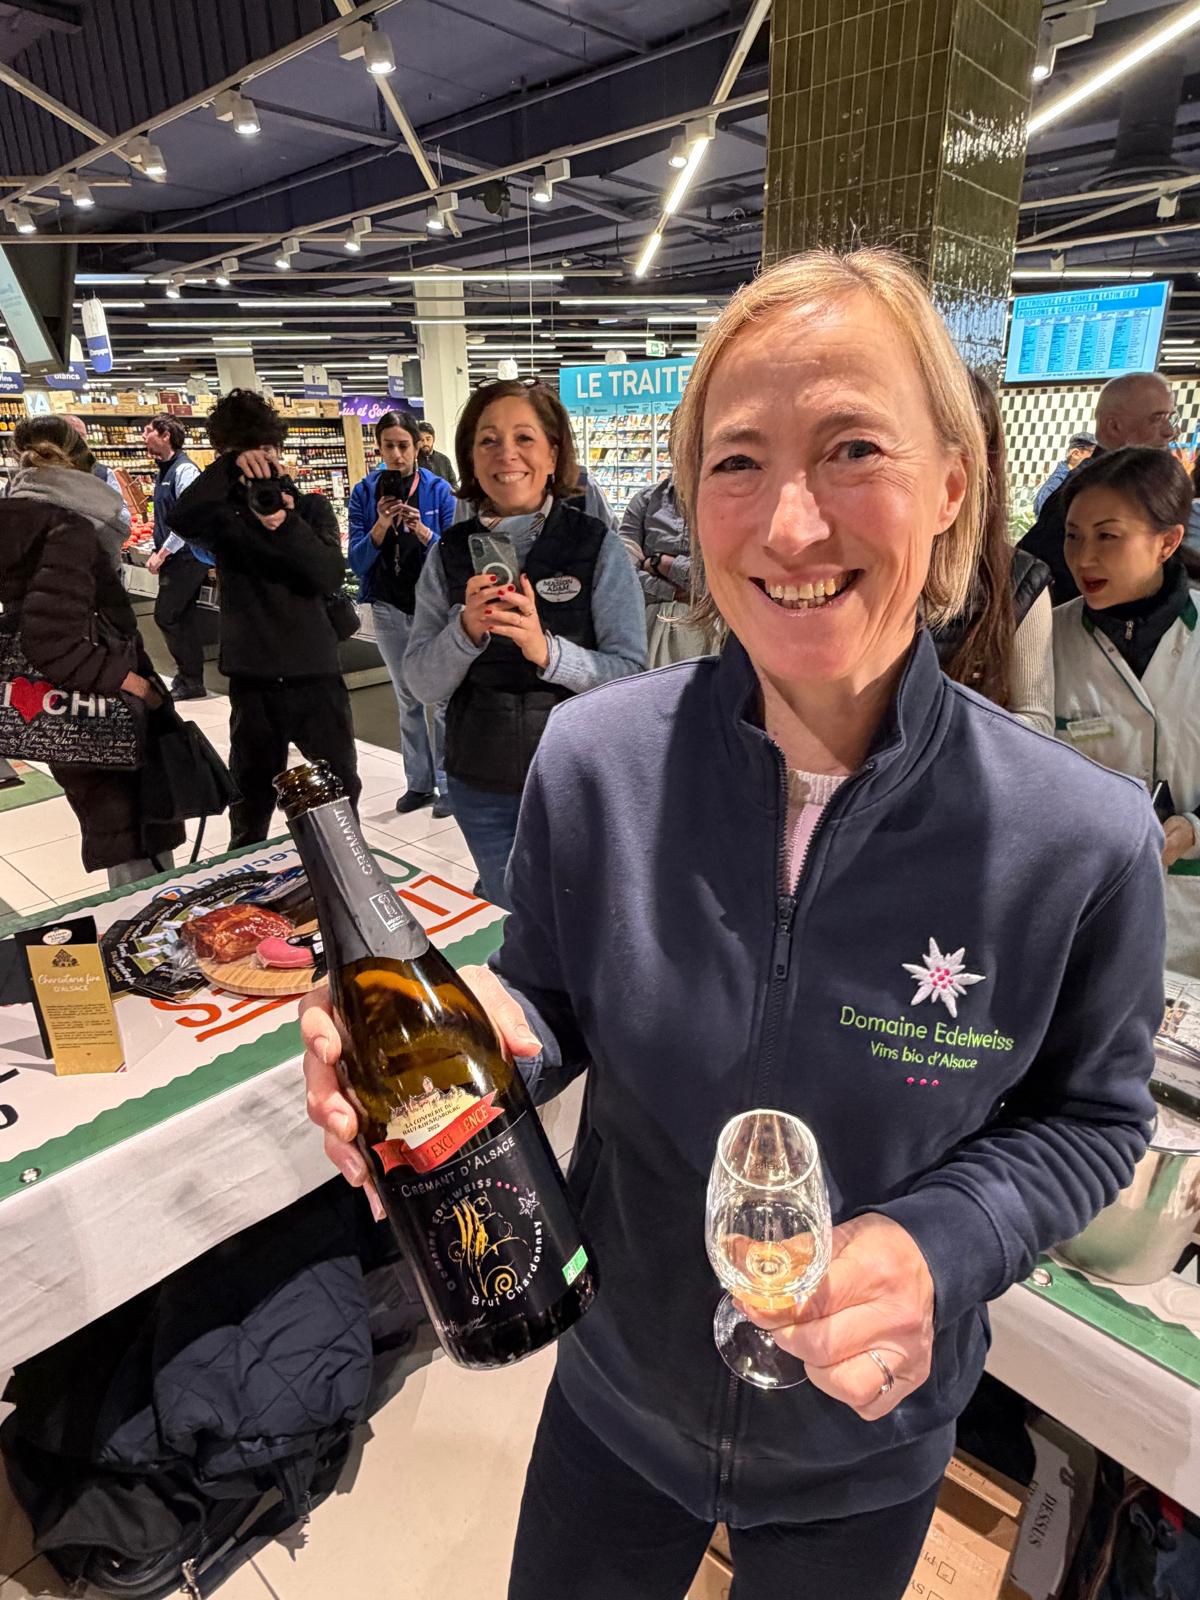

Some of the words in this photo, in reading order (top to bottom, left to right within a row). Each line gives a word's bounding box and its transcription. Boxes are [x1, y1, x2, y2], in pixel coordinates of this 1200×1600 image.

[576, 372, 602, 399] LE
[608, 365, 693, 396] TRAITE
[356, 404, 368, 417] et
[368, 403, 395, 419] Sod
[42, 689, 116, 718] CHI
[839, 1005, 928, 1039] Domaine
[934, 1021, 1015, 1051] Edelweiss
[870, 1041, 899, 1060] Vins
[902, 1046, 924, 1064] bio
[927, 1052, 978, 1069] d'Alsace
[471, 1293, 501, 1307] Brut
[505, 1220, 543, 1301] Chardonnay
